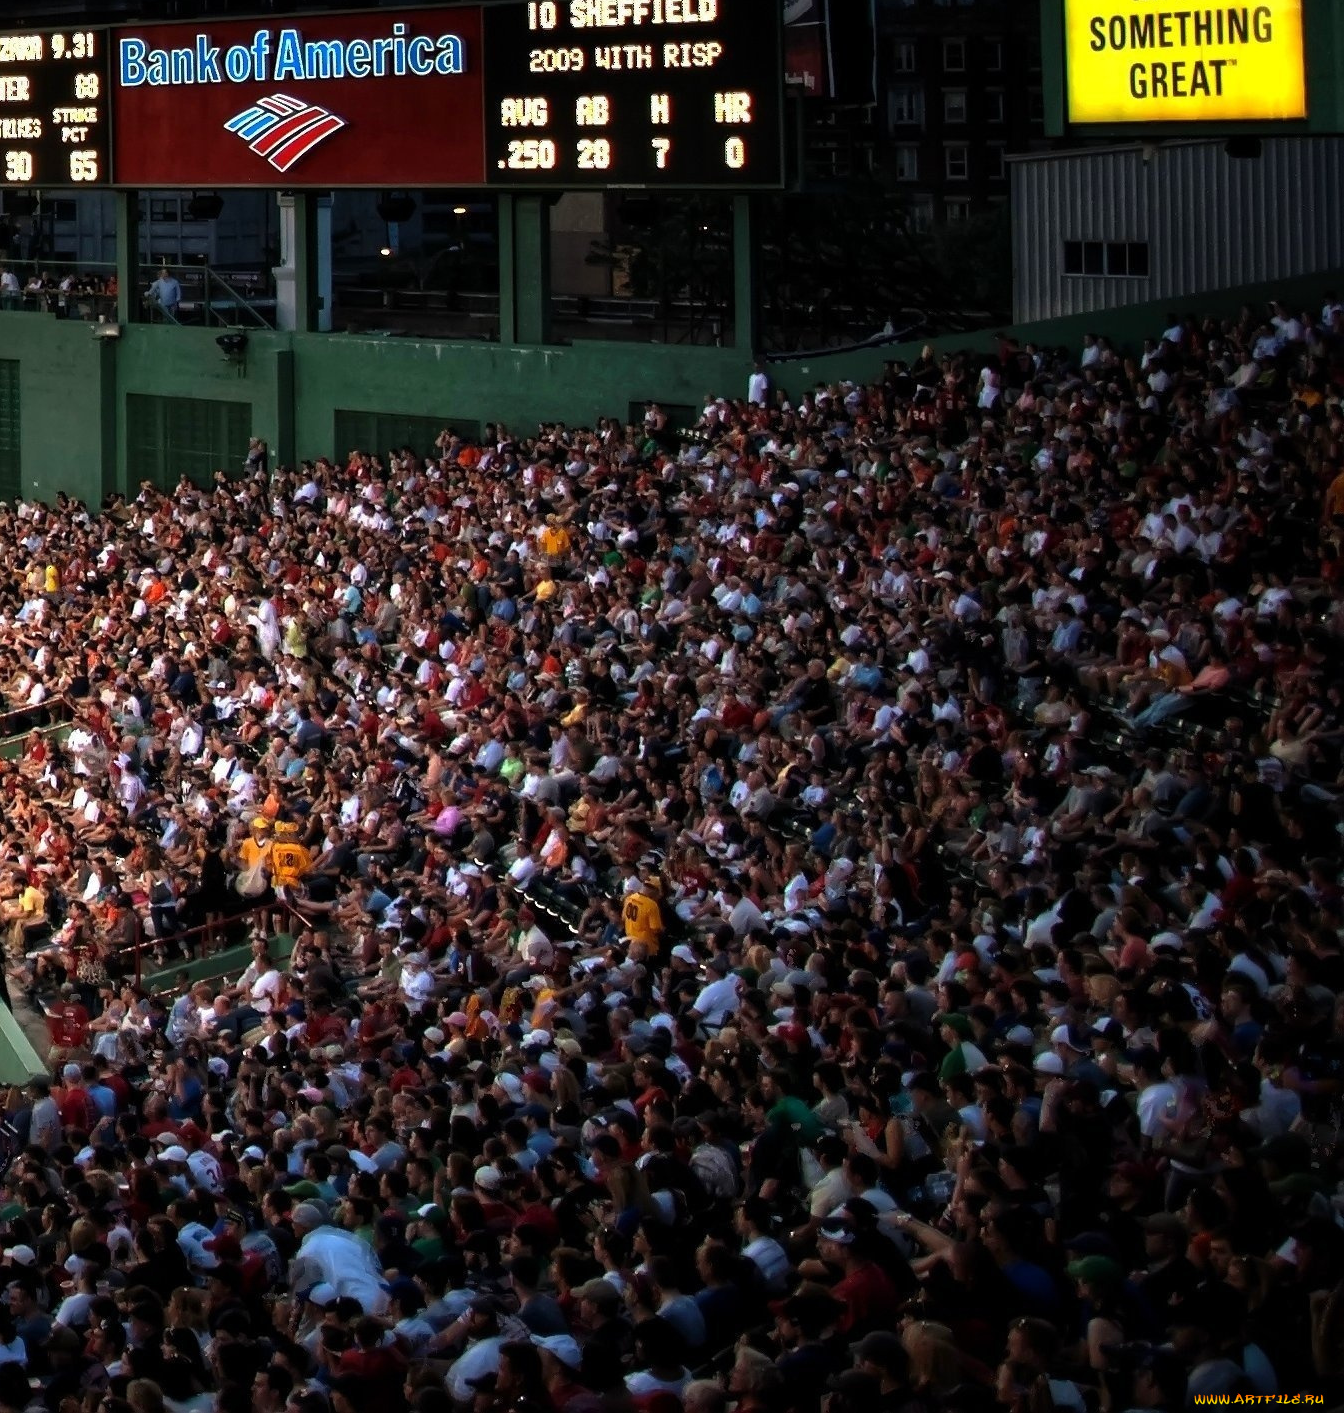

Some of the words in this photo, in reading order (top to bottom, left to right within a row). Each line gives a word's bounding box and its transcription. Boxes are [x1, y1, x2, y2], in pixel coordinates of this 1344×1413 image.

[528, 1, 557, 30] 10
[1089, 6, 1272, 52] SOMETHING
[51, 32, 94, 59] 9.31
[120, 35, 222, 87] Bank
[225, 30, 269, 83] of
[274, 23, 463, 81] America
[529, 48, 584, 72] 2009
[595, 45, 652, 70] WITH
[663, 42, 722, 68] RISP
[52, 107, 98, 124] STRIKE
[500, 97, 548, 127] AVG
[576, 95, 609, 126] AB
[650, 93, 670, 124] H
[714, 92, 751, 124] HR
[61, 126, 89, 143] PCT
[5, 151, 33, 181] 30
[70, 150, 98, 181] 65
[498, 139, 556, 170] .250
[577, 138, 610, 170] 28
[651, 138, 670, 169] 7
[724, 137, 746, 169] 0
